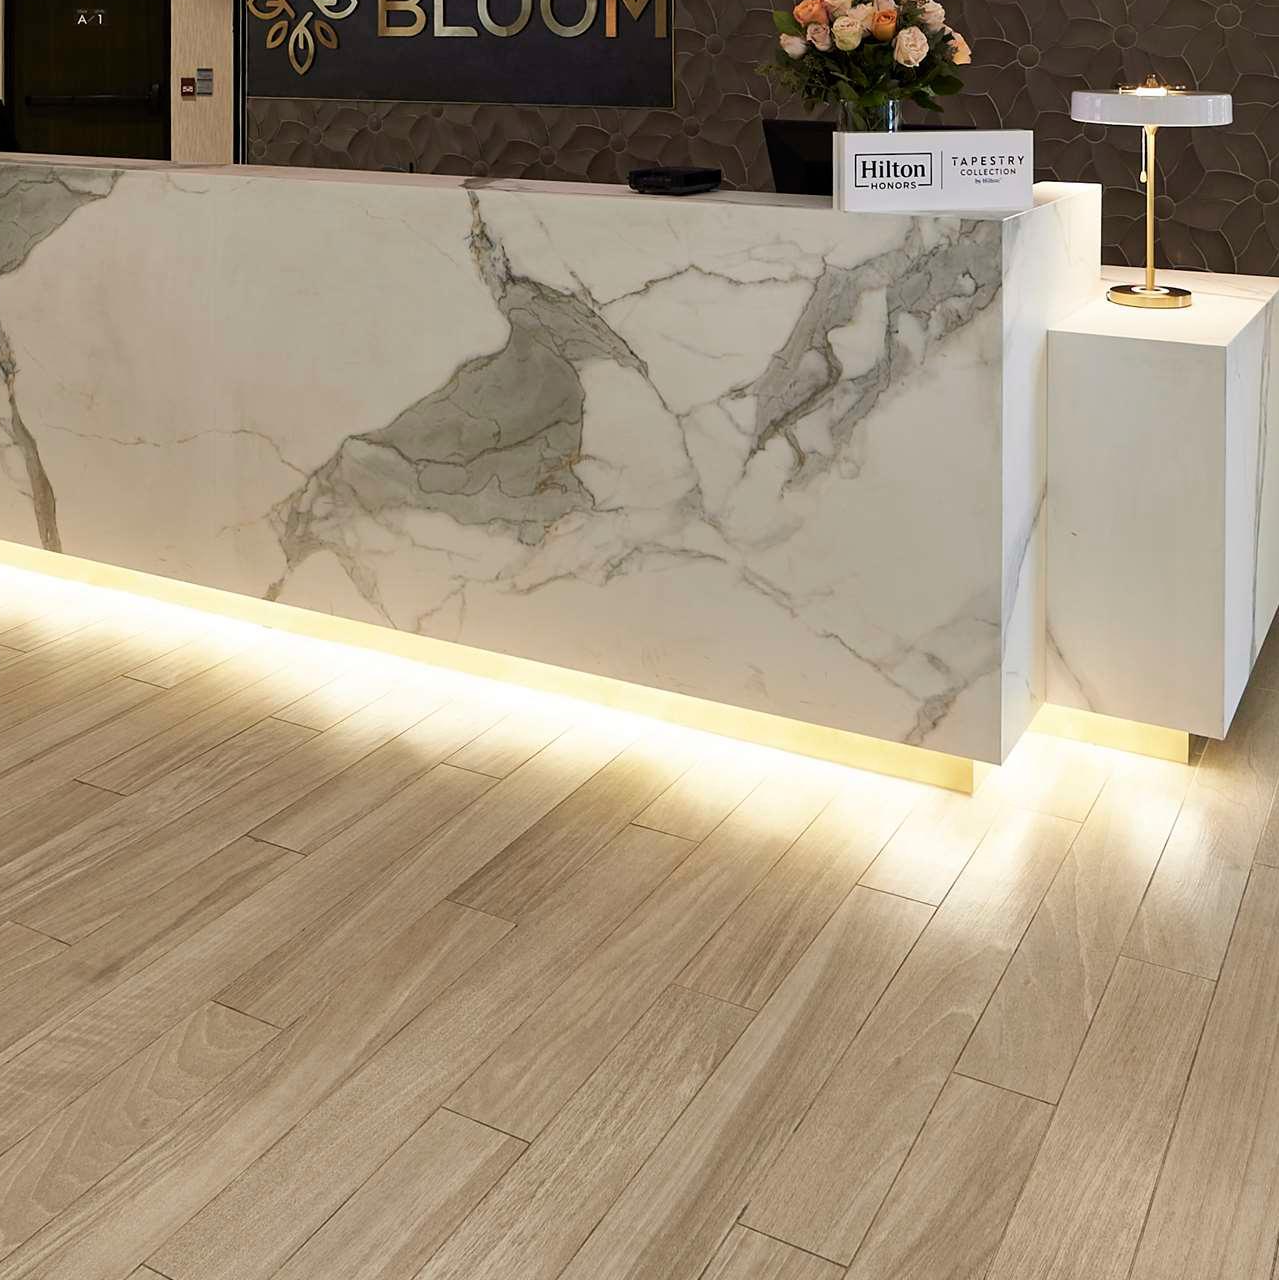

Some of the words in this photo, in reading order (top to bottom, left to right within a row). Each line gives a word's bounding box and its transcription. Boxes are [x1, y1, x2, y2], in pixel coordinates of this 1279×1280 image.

[77, 14, 88, 25] A
[951, 155, 1024, 166] TAPESTRY
[862, 160, 926, 178] Hilton
[960, 168, 1016, 176] COLLECTION
[871, 181, 917, 190] HONORS
